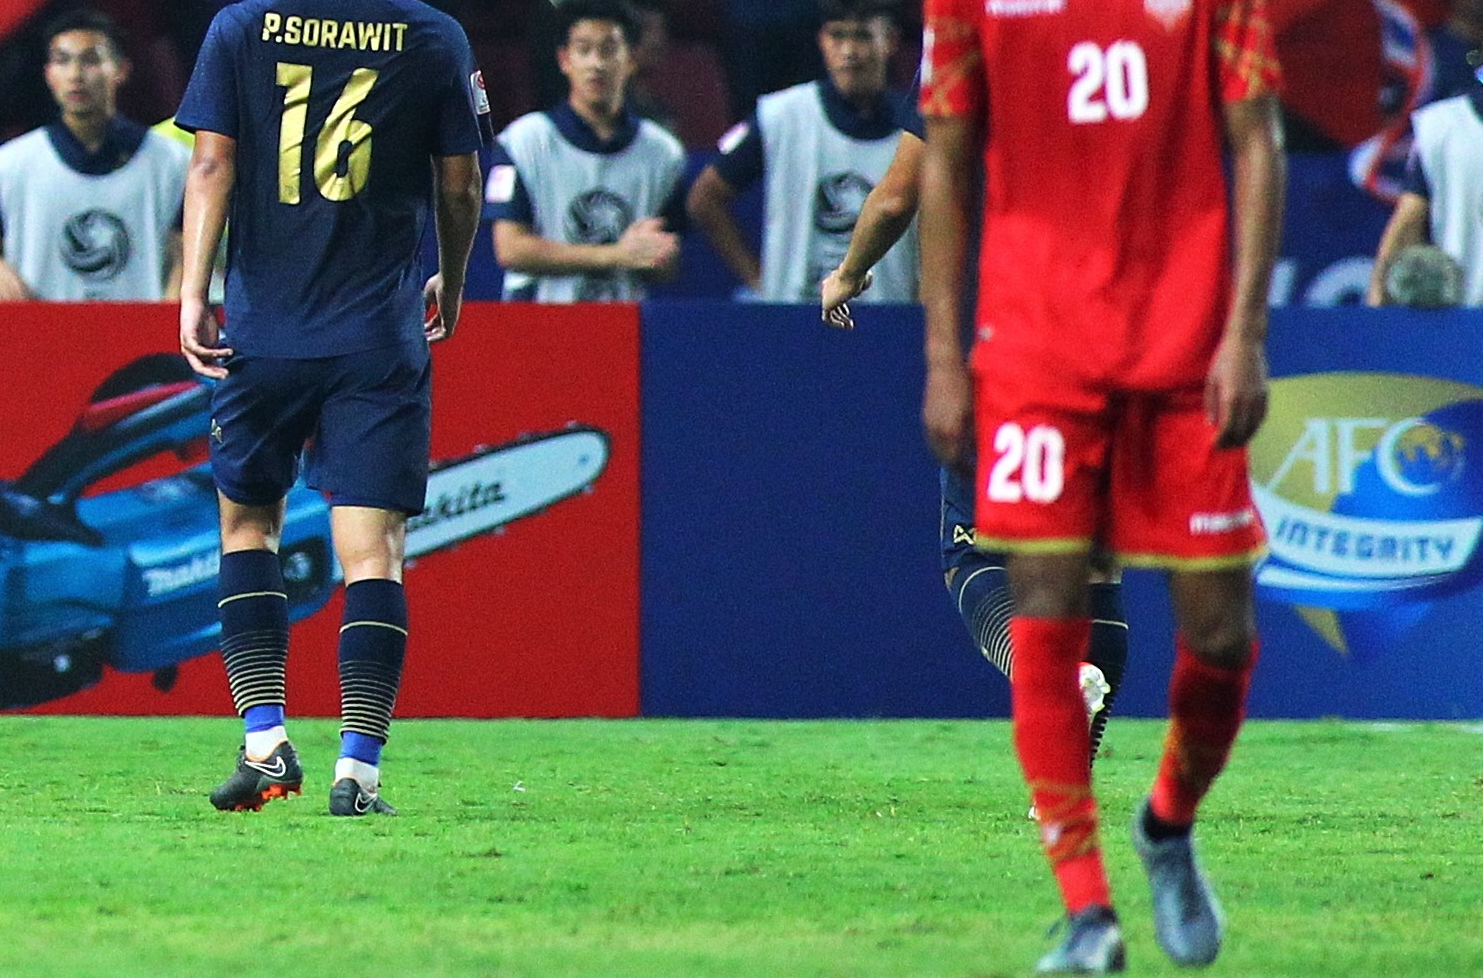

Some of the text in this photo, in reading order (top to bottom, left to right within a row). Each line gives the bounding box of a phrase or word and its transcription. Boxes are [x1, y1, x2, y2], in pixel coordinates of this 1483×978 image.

[262, 12, 408, 52] P.SORAWIT
[1068, 41, 1150, 123] 20
[276, 61, 380, 205] 16
[987, 422, 1065, 504] 20
[1266, 416, 1452, 497] AFC
[1275, 518, 1455, 564] INTEGRITY
